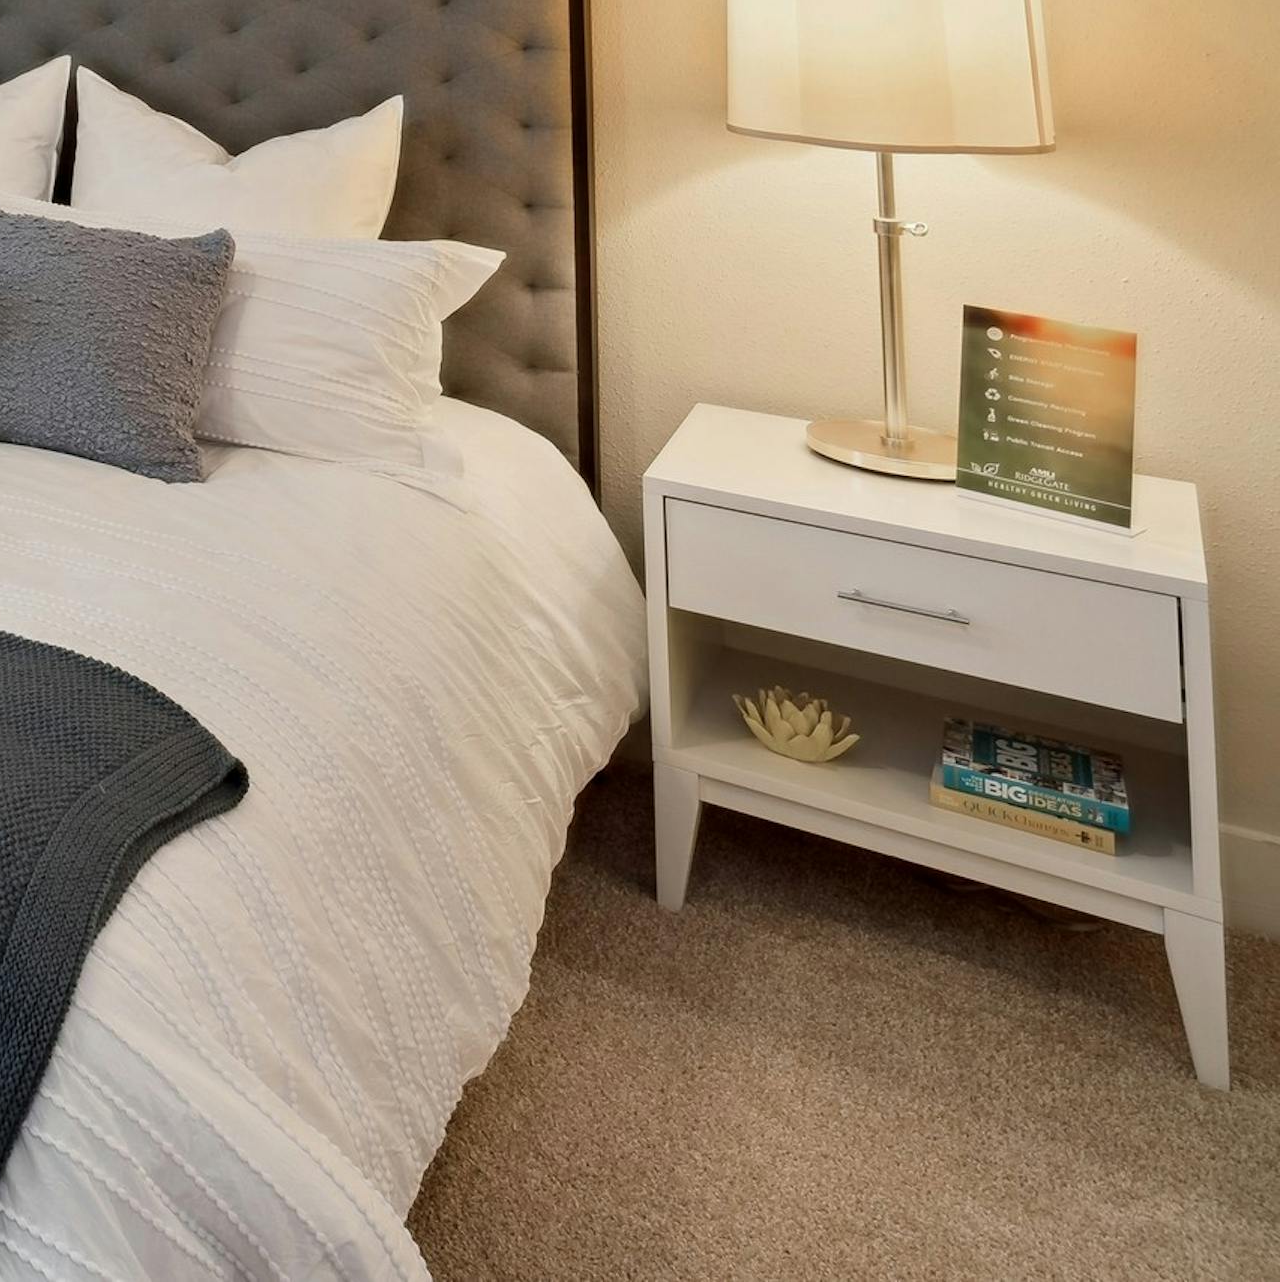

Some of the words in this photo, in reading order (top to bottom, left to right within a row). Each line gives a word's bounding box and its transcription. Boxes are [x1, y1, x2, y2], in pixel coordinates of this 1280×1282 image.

[1007, 414, 1029, 425] Green
[1030, 419, 1063, 433] Cleaning
[1064, 427, 1097, 440] Program
[1006, 435, 1028, 446] Public
[1056, 446, 1084, 458] Access
[988, 481, 1026, 495] HEALTHY
[1030, 491, 1060, 503] GREEN
[1064, 498, 1097, 512] LIVING
[995, 738, 1038, 773] BIG
[984, 779, 1028, 804] BIG
[1028, 794, 1083, 818] IDEAS
